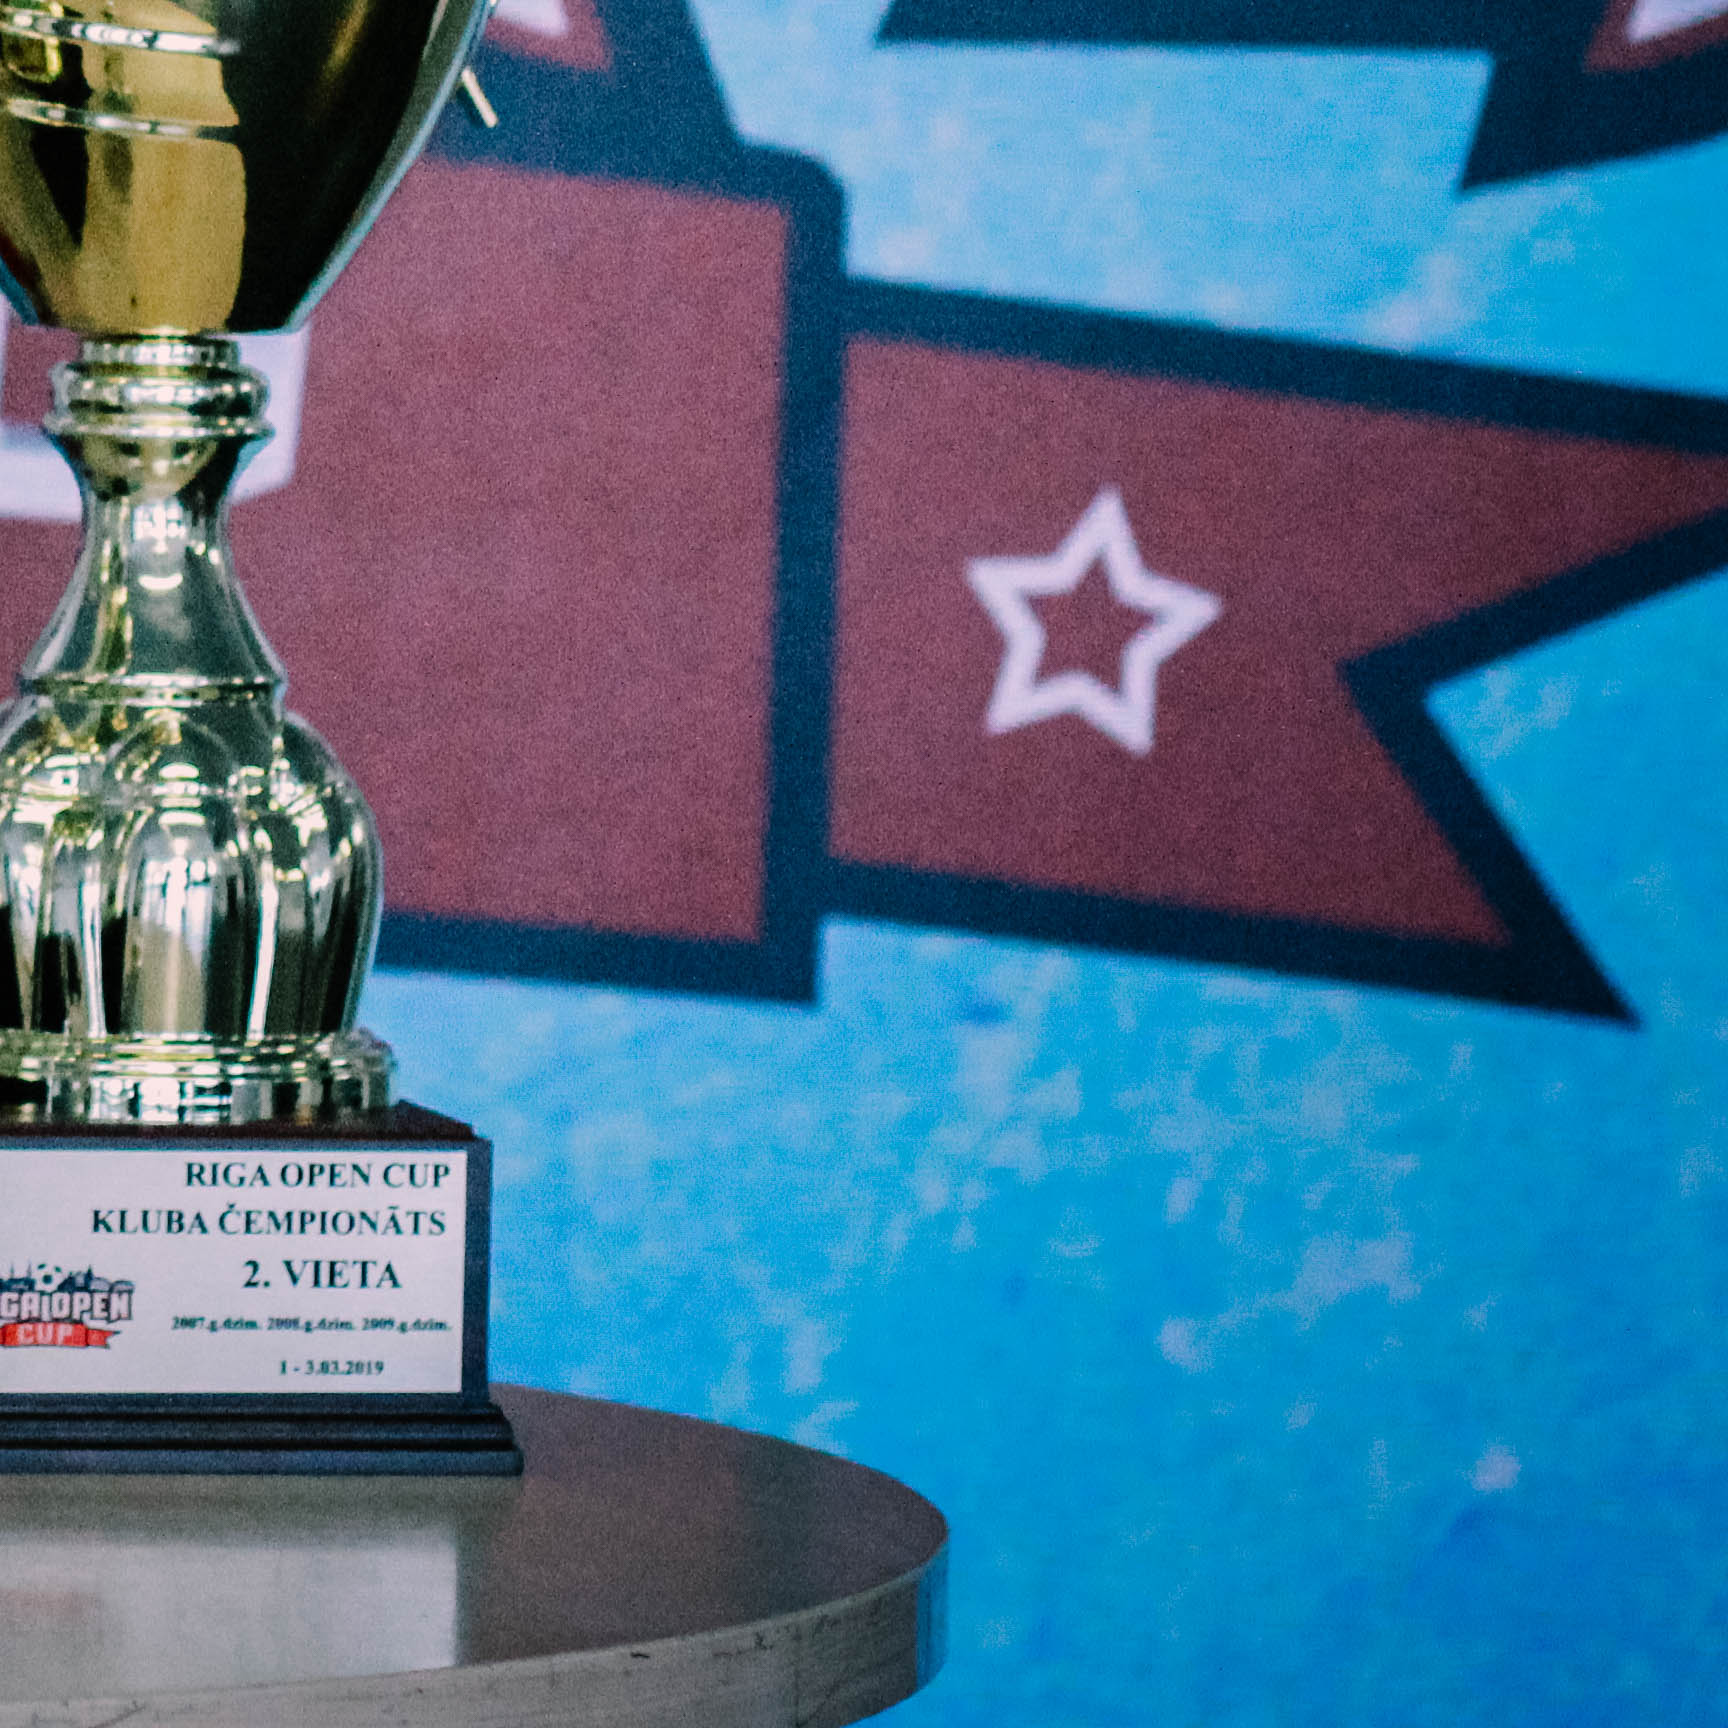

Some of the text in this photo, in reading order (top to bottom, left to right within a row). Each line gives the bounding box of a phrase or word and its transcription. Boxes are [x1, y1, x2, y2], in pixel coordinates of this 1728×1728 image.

[186, 1162, 451, 1188] RIGA OPEN CUP
[92, 1203, 446, 1236] KLUBA ČEMPIONĀTS
[243, 1259, 402, 1289] 2. VIETA
[51, 1290, 132, 1322] OPEN
[16, 1323, 74, 1344] CUP
